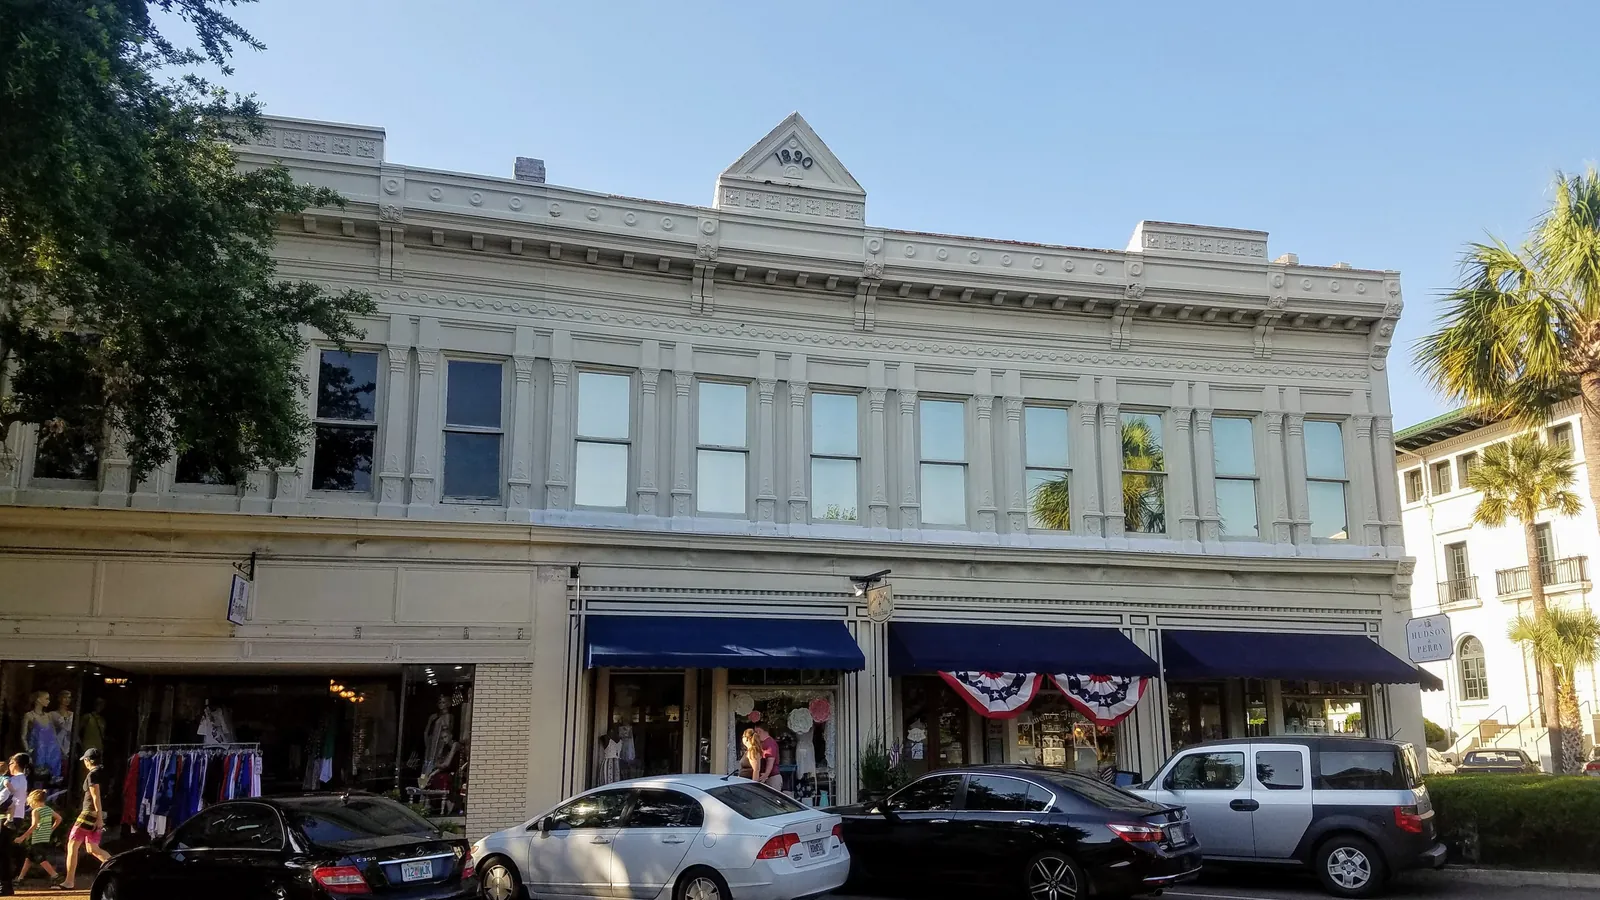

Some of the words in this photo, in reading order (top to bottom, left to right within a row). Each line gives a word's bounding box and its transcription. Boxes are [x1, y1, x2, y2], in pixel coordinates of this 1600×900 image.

[775, 149, 813, 168] 1890
[1411, 628, 1446, 640] HUDSON
[1417, 643, 1444, 653] PERRY
[1060, 709, 1080, 721] Fine
